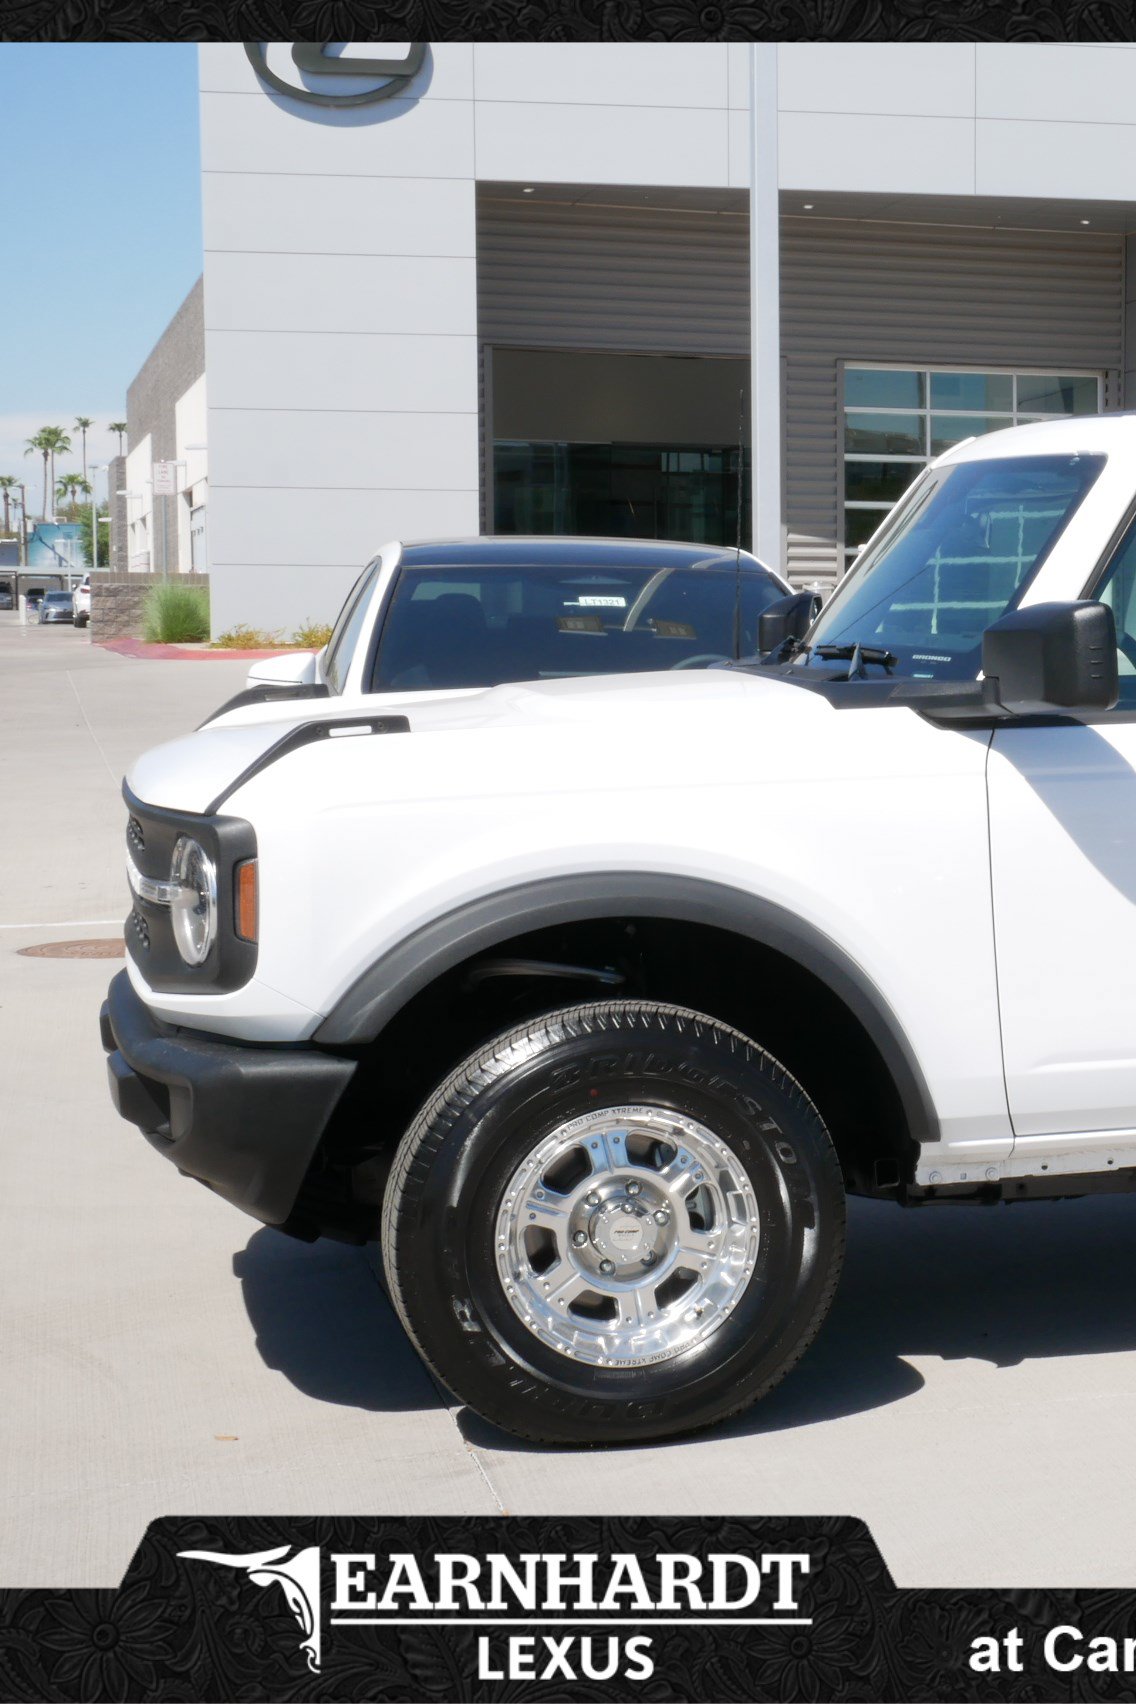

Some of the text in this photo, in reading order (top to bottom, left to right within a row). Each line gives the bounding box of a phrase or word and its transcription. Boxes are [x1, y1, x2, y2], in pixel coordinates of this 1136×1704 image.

[912, 654, 952, 662] BRONCO
[567, 1107, 644, 1131] PRO COMP XTREME
[614, 1358, 647, 1366] XTREME
